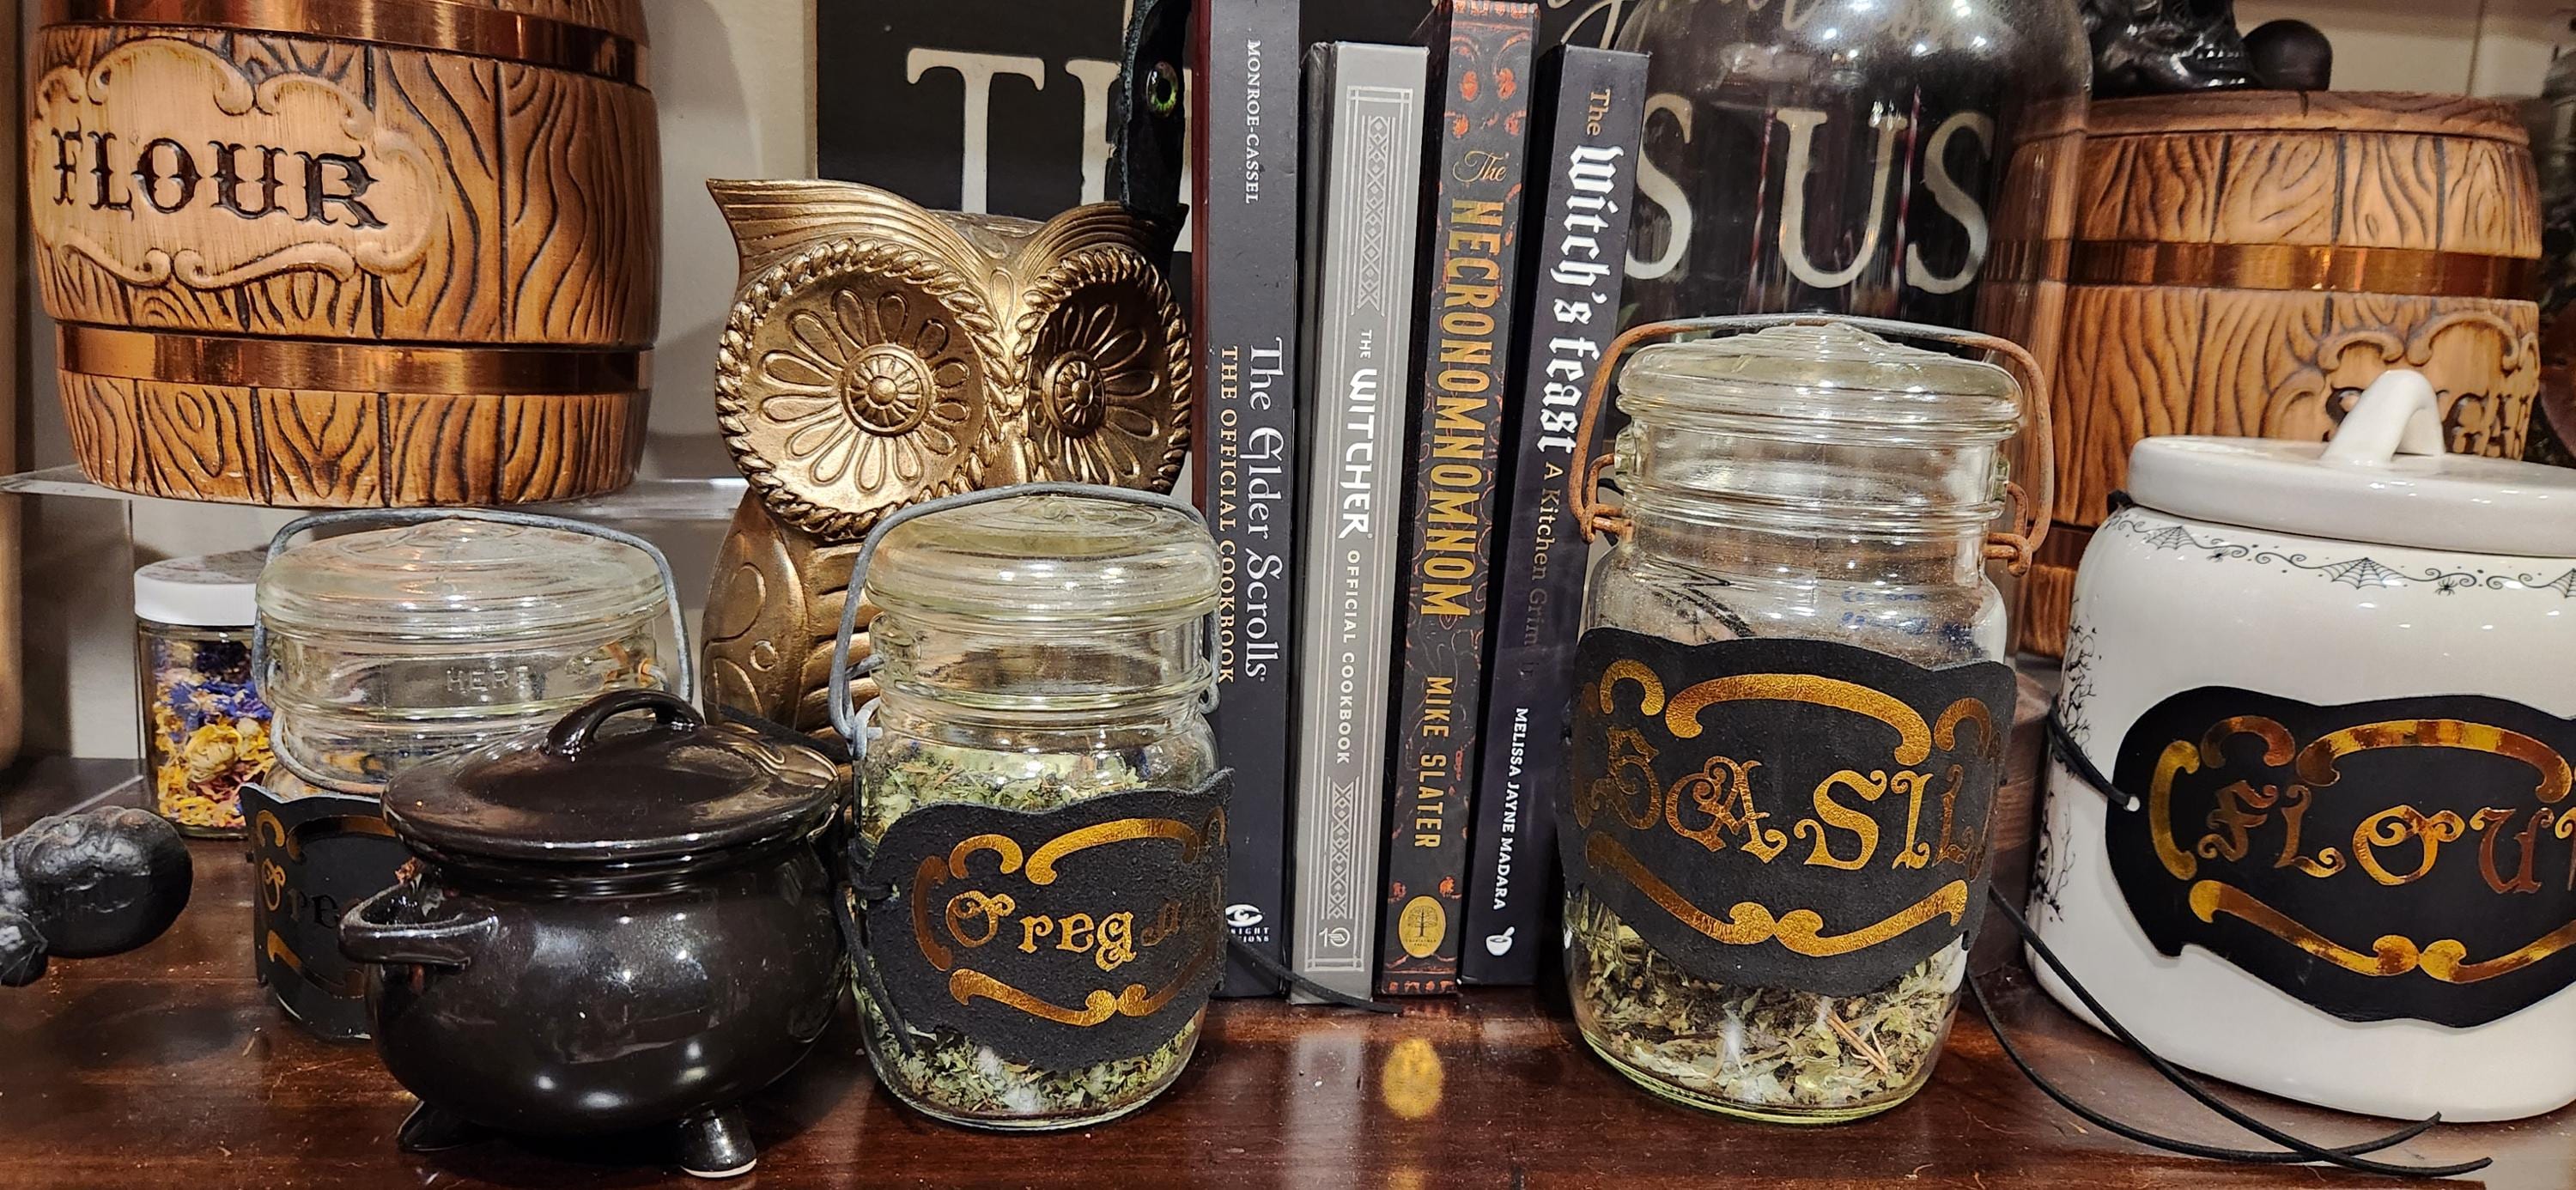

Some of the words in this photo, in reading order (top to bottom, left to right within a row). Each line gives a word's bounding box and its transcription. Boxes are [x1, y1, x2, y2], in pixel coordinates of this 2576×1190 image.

[1246, 39, 1262, 204] MONROE-CASSEL
[1586, 88, 1613, 136] The
[51, 125, 388, 229] FLOUR
[1453, 150, 1508, 182] The
[1624, 93, 1694, 281] S
[1776, 109, 1996, 294] US
[1550, 144, 1625, 325] Witch's
[1221, 346, 1239, 398] THE
[1249, 337, 1285, 410] The
[1359, 329, 1372, 360] THE
[1339, 368, 1377, 539] WITCHER
[1422, 198, 1505, 617] NECRONOMNOMNOM
[1218, 410, 1237, 531] OFFICIAL
[1240, 427, 1285, 540] Elder
[1544, 462, 1564, 480] A
[1531, 488, 1561, 580] Kitchen
[1218, 540, 1236, 683] COOKBOOK
[1245, 547, 1284, 677] Scrolls
[1342, 550, 1360, 643] OFFICIAL
[1337, 652, 1356, 764] COOKBOOK
[1423, 677, 1453, 738] MIKE
[1510, 707, 1529, 776] MELISSA
[1414, 753, 1446, 848] SLATER
[1503, 780, 1522, 834] JAYNE
[1589, 725, 1976, 871] BASIL
[2197, 780, 2575, 894] FLOU
[1492, 837, 1514, 910] MADARA
